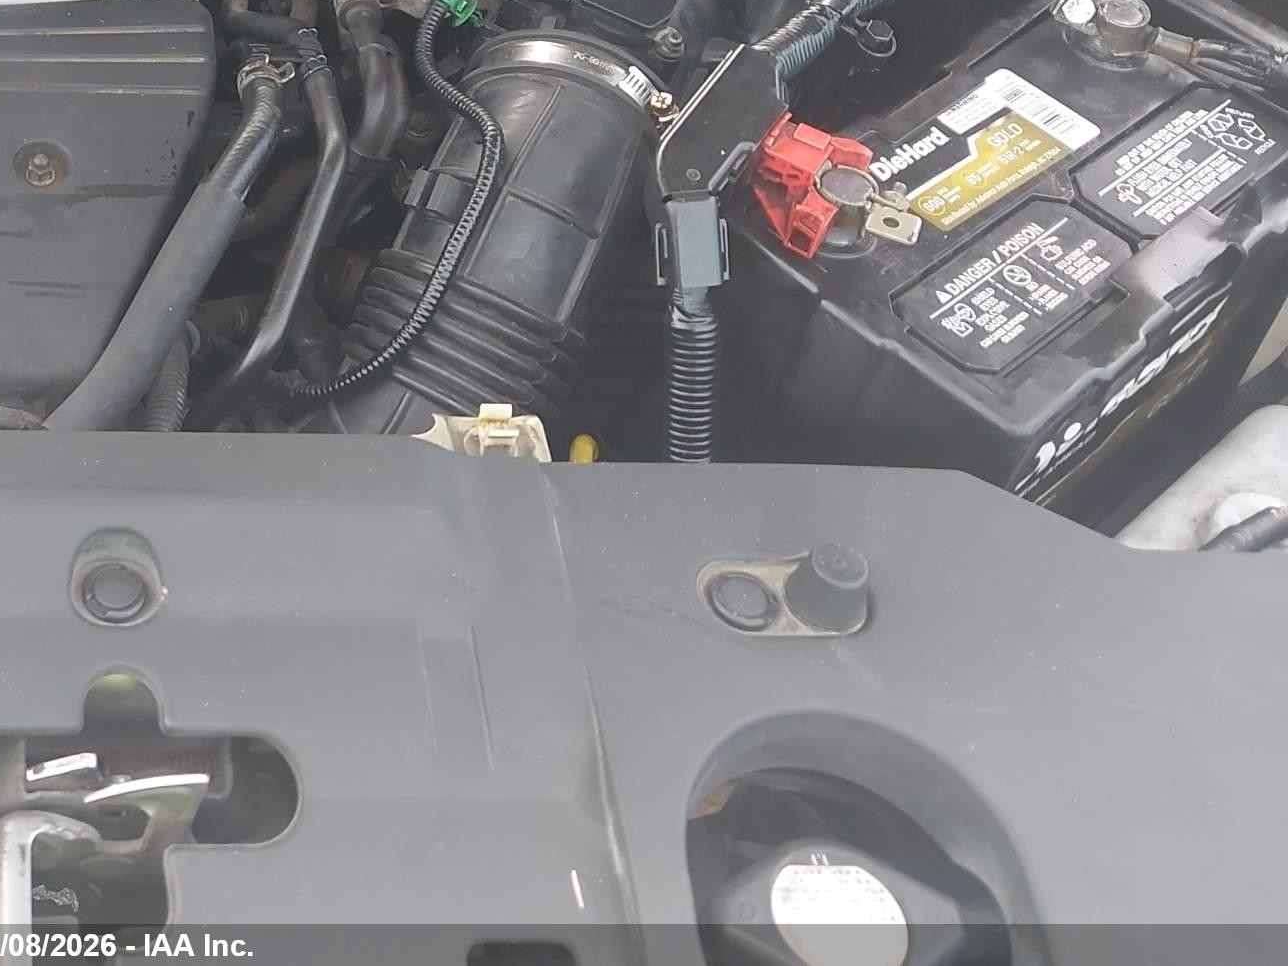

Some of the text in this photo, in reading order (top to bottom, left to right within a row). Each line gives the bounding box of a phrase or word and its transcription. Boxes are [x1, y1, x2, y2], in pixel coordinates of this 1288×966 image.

[869, 126, 950, 182] DieHard
[987, 122, 1023, 147] GOLD
[944, 257, 997, 296] DANGER
[997, 222, 1045, 257] POISON
